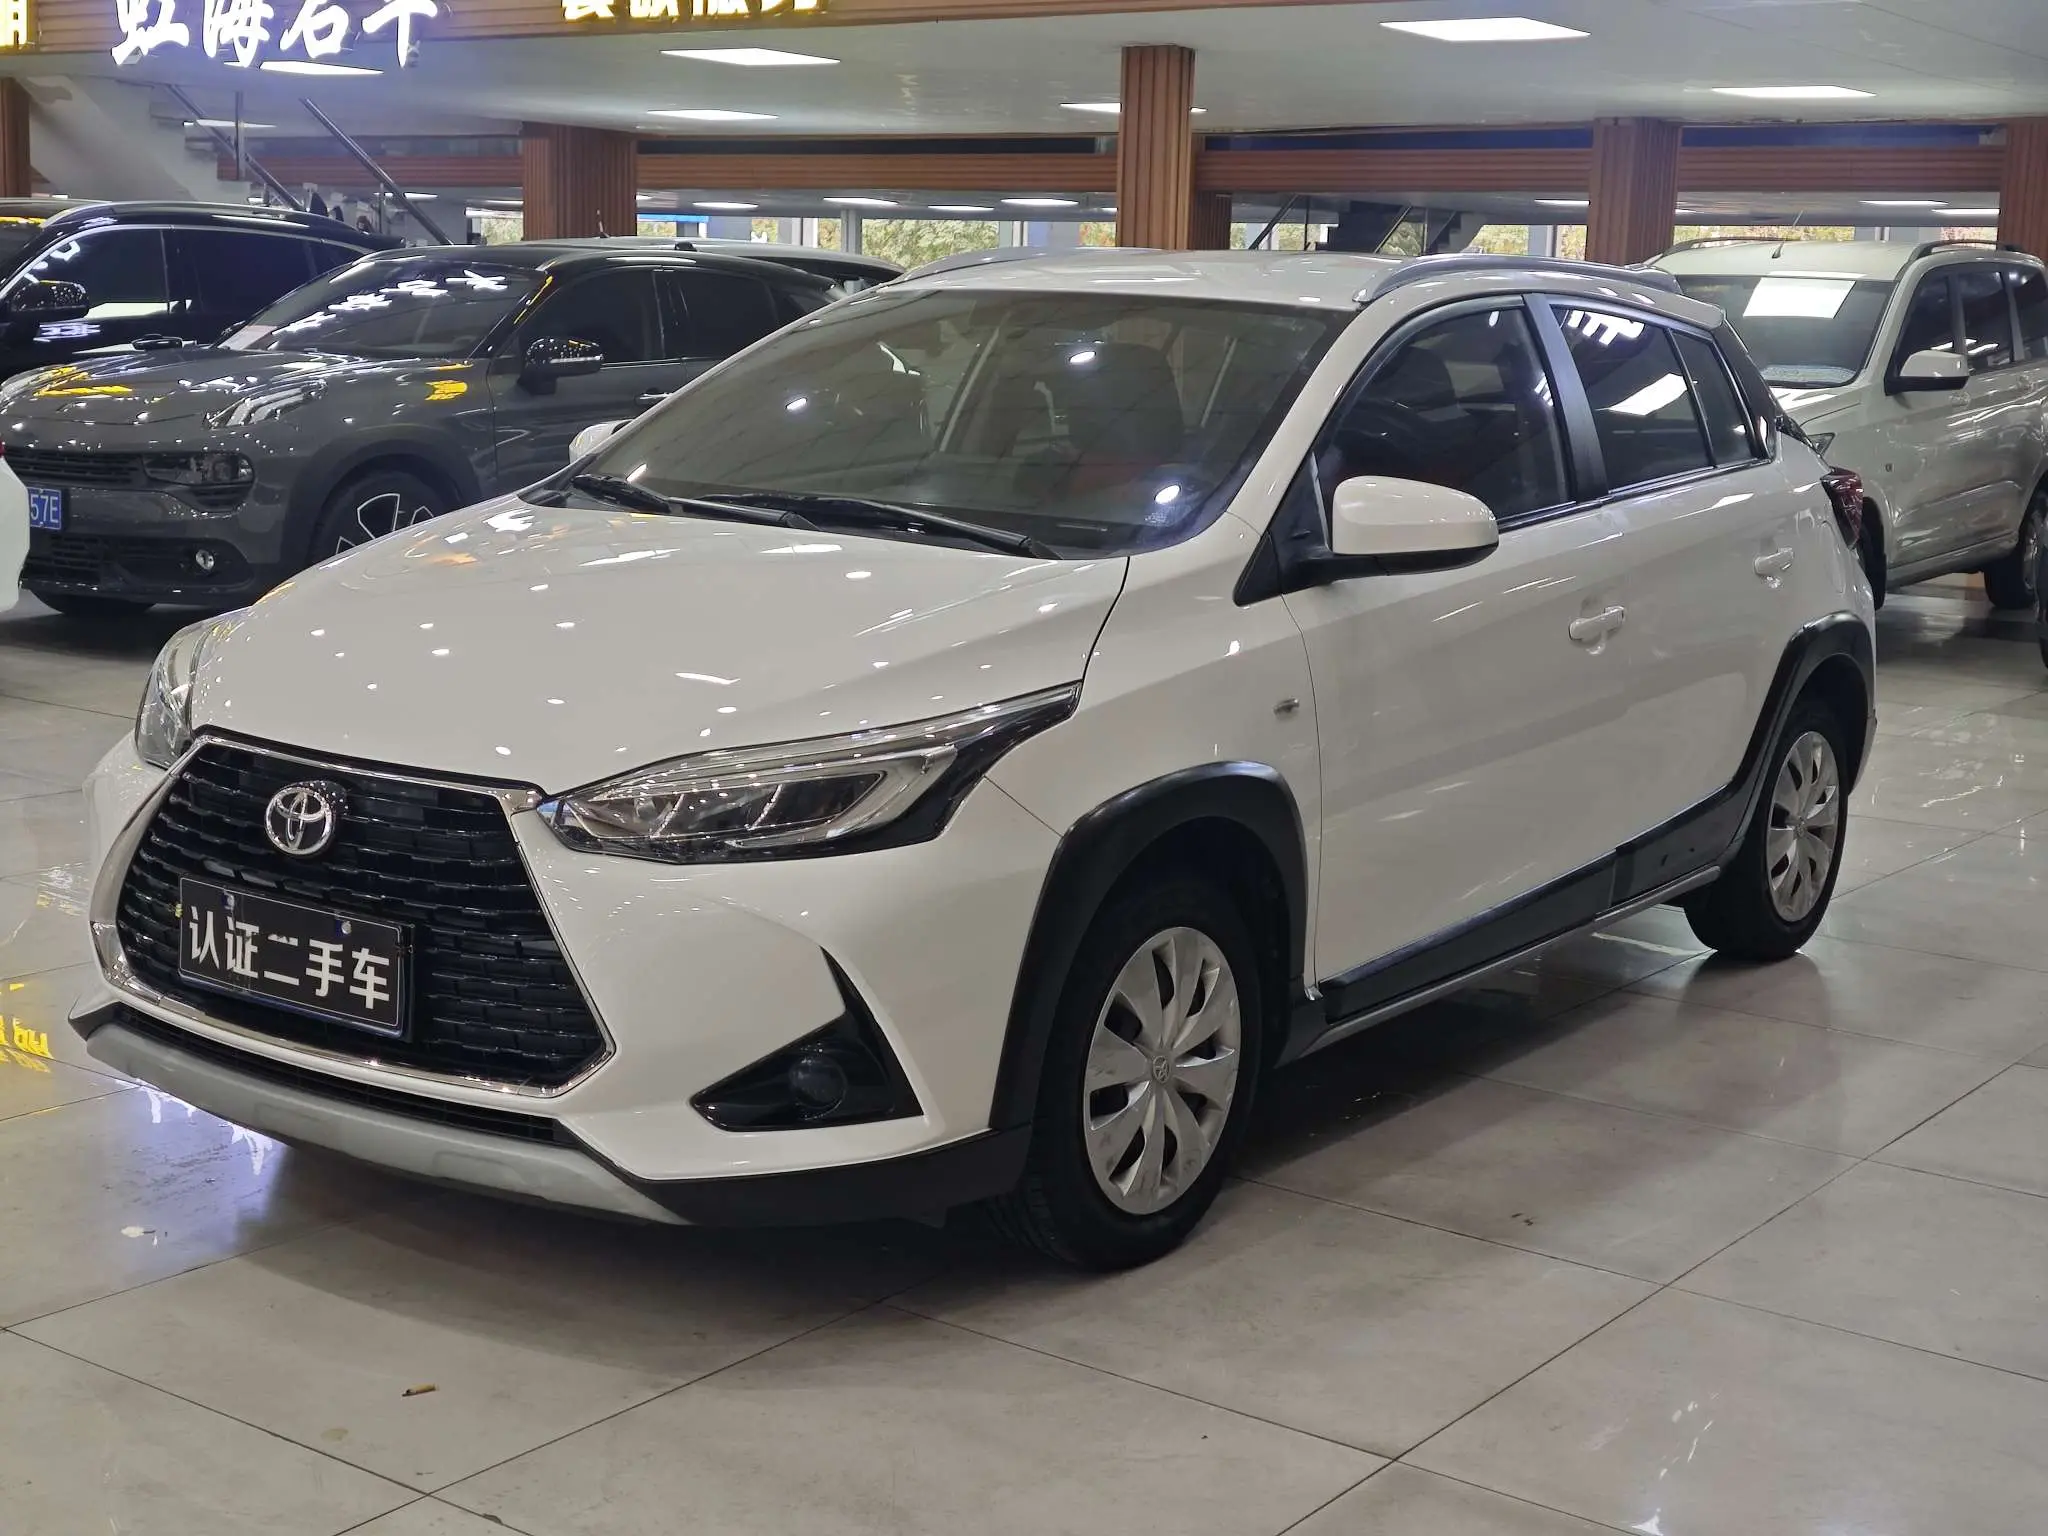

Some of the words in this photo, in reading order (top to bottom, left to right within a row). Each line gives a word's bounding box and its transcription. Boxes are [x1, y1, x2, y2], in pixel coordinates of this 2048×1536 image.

[188, 905, 390, 1010] 认证二手车
